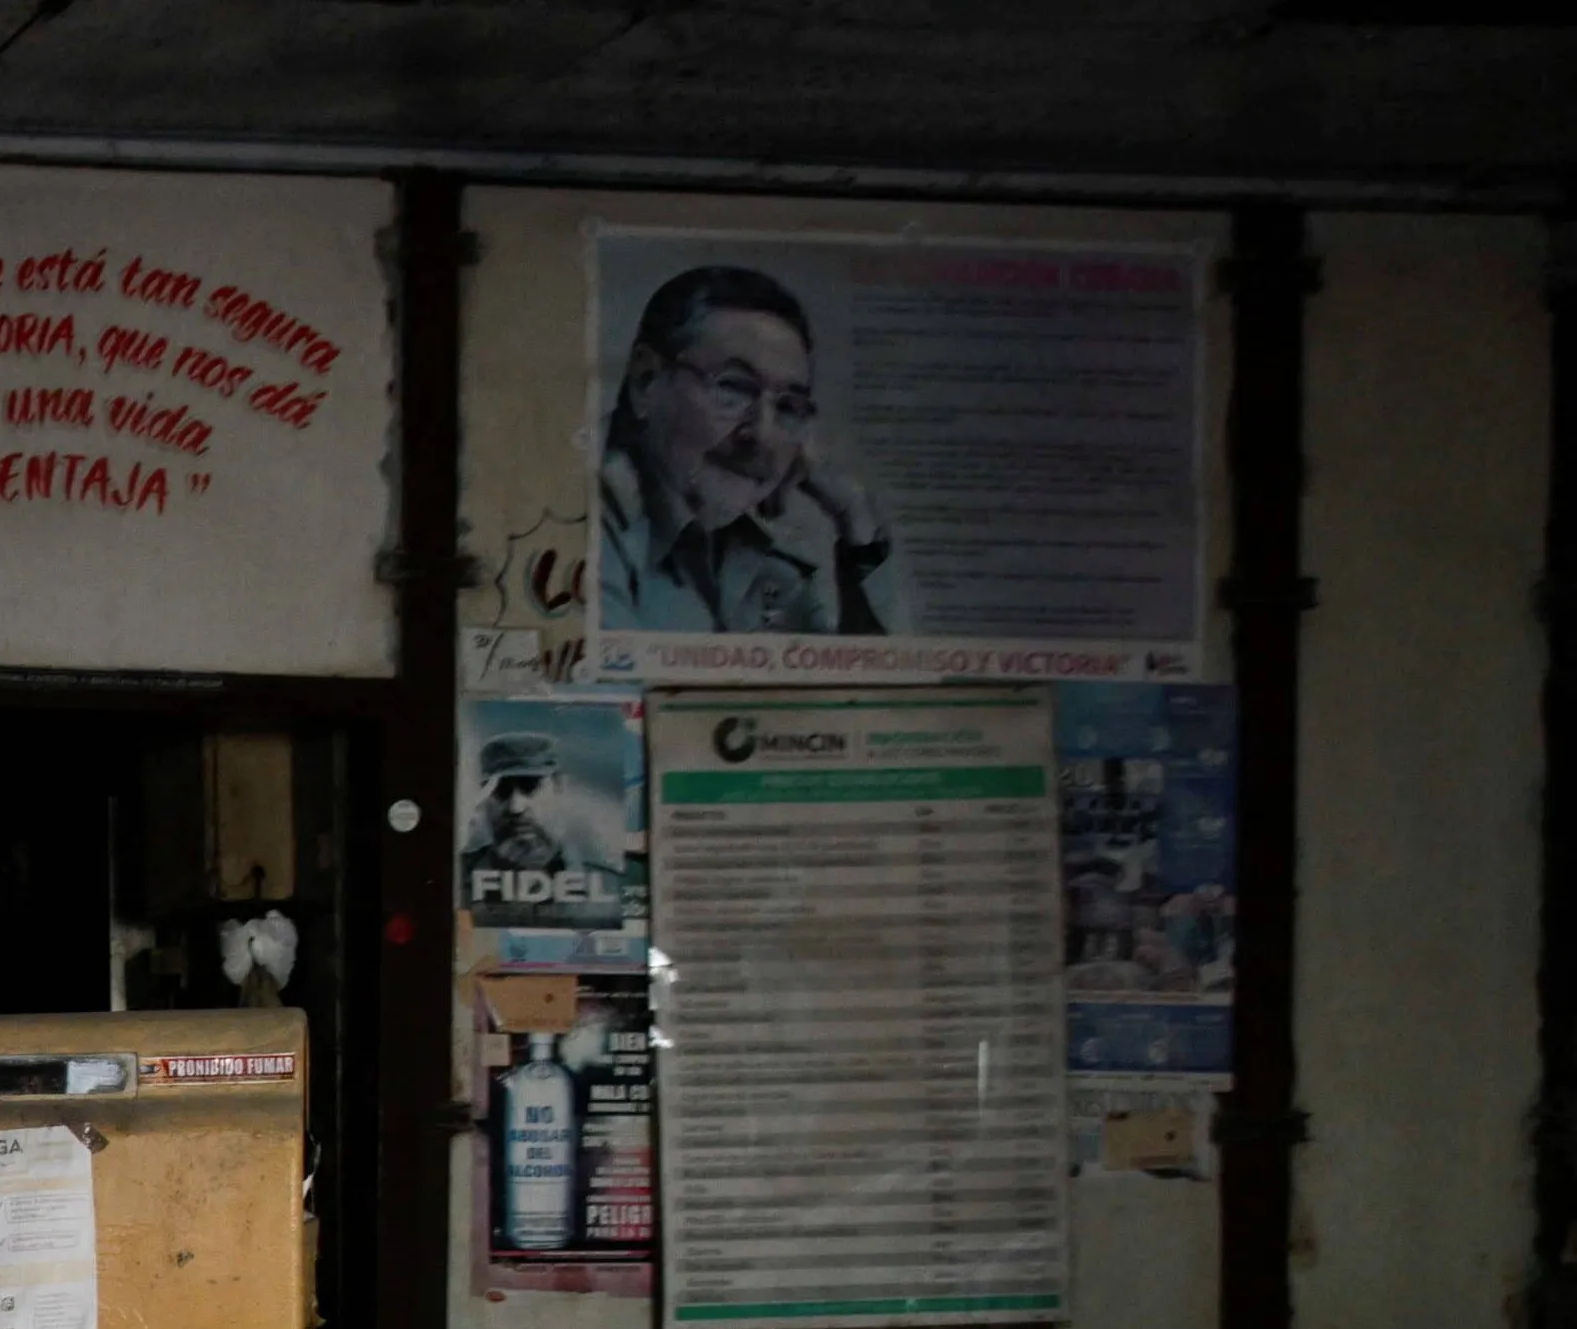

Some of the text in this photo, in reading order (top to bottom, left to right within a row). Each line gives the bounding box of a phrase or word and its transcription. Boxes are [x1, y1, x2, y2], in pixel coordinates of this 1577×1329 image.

[15, 246, 109, 295] está
[119, 256, 202, 309] tan
[203, 282, 342, 375] segura
[96, 322, 166, 375] que
[170, 341, 253, 398] nos
[249, 375, 329, 431] dá
[5, 384, 96, 430] una
[108, 392, 214, 457] vida
[471, 869, 620, 903] FIDEL
[168, 1056, 295, 1078] PROHIBIDO FUMAR
